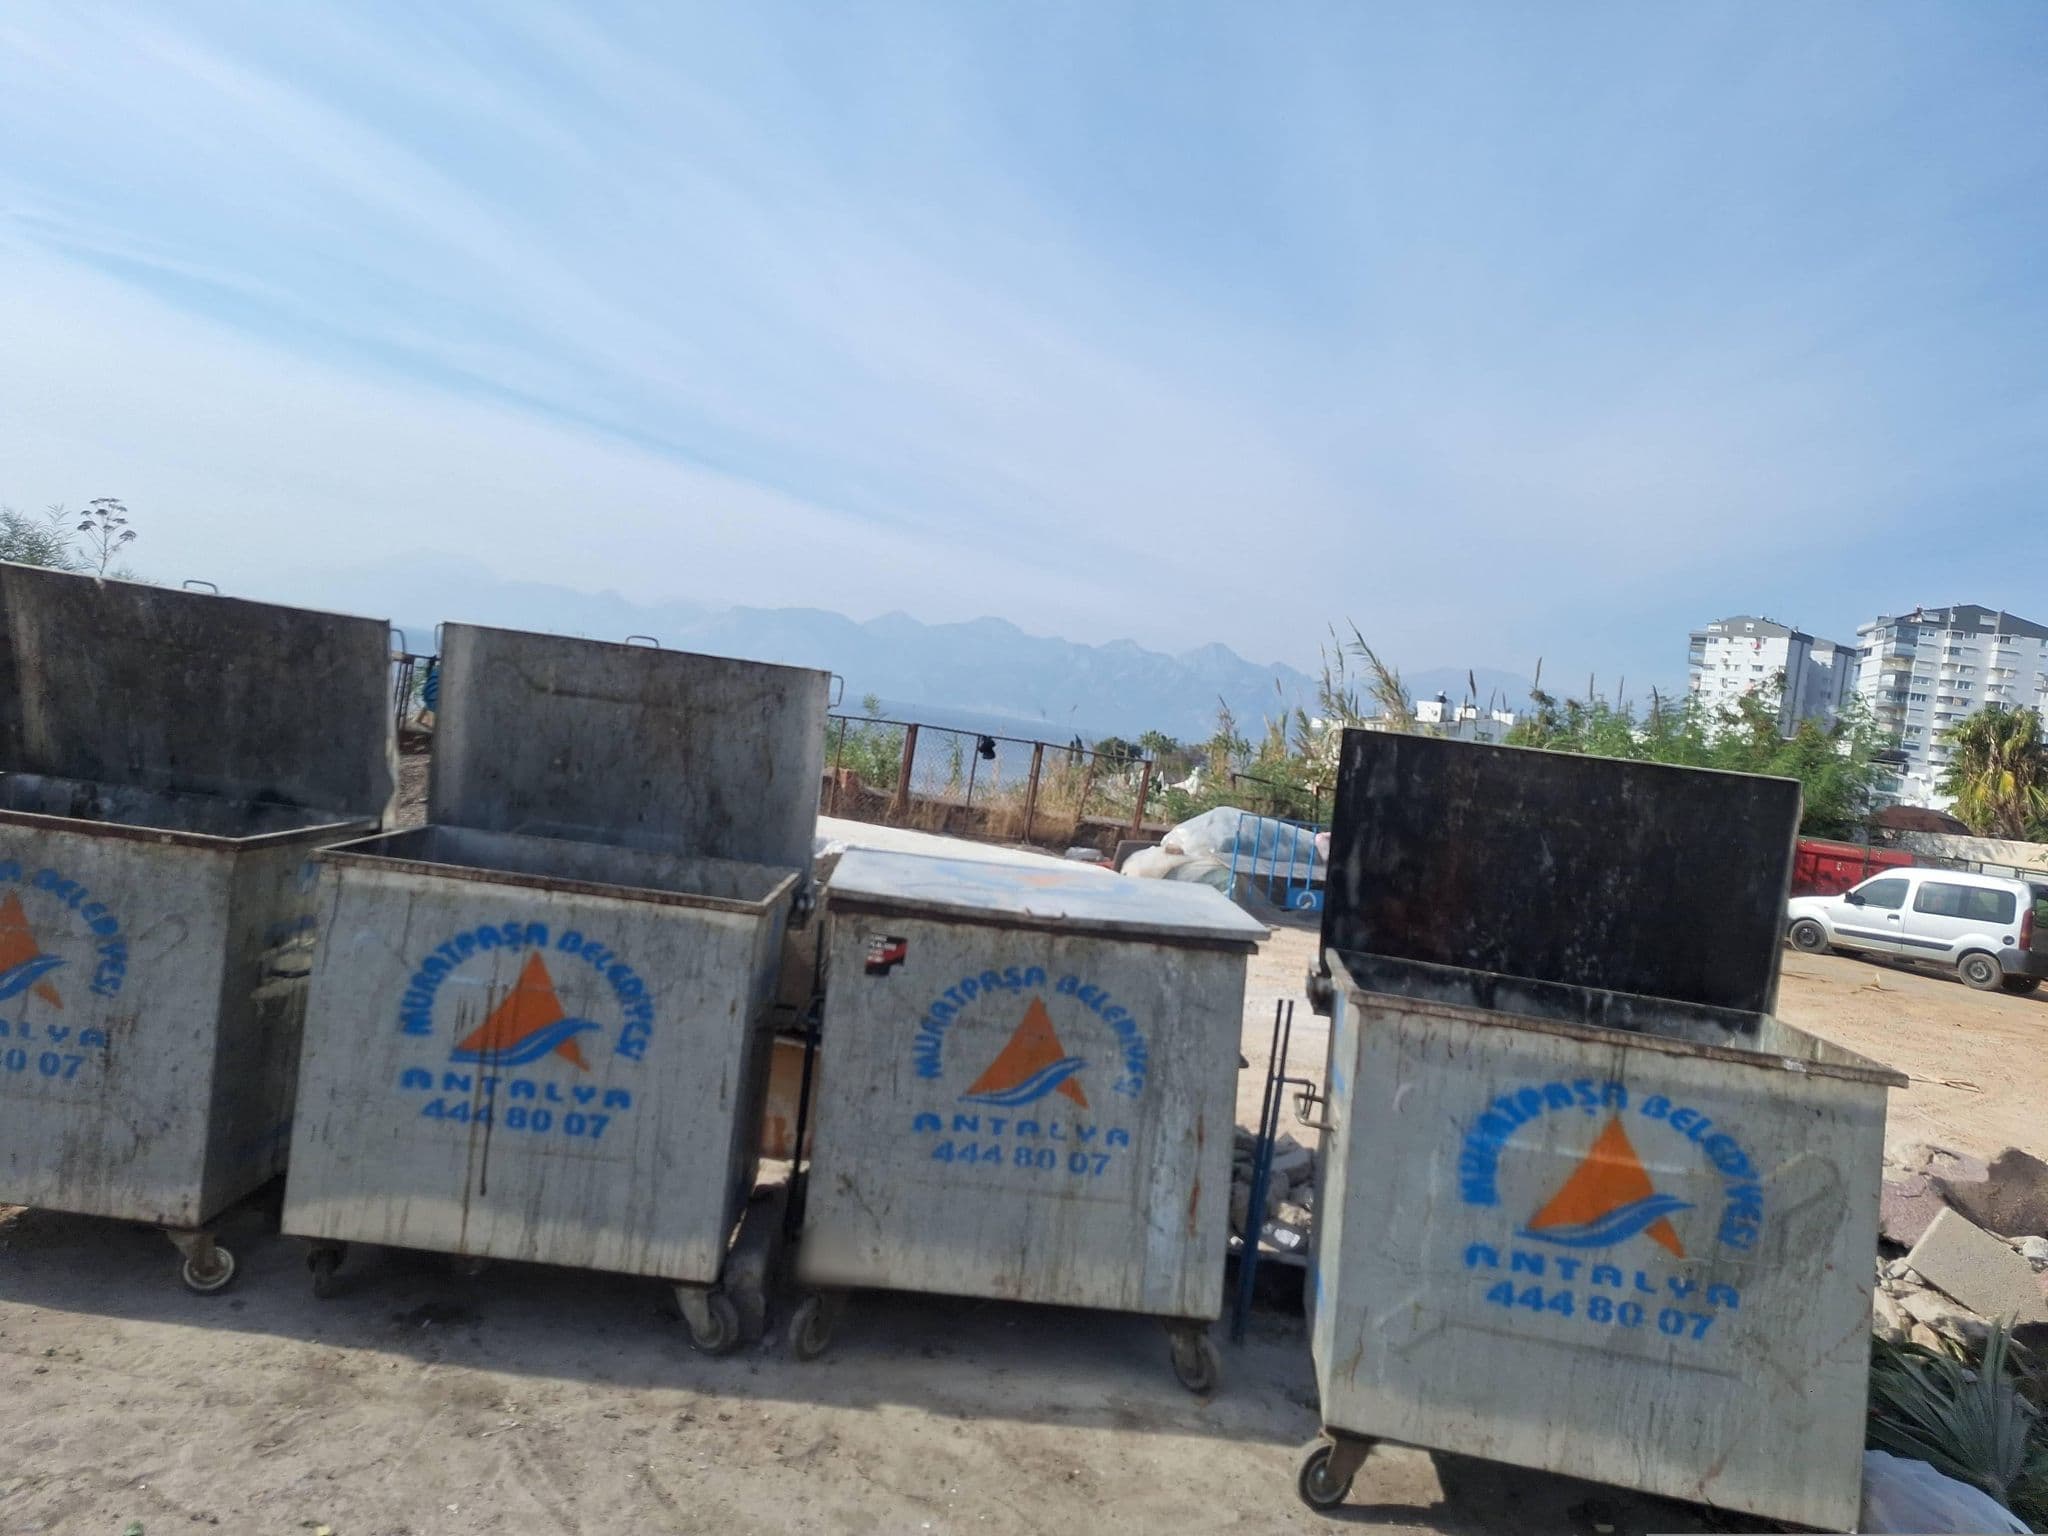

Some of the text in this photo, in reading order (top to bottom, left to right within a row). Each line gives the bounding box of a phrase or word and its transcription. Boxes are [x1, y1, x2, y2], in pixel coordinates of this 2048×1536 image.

[38, 1052, 84, 1079] 07
[400, 1066, 632, 1110] ANTALYA
[421, 1097, 612, 1140] 444 80 07
[912, 1112, 1130, 1148] ANTALYA
[932, 1140, 1111, 1176] 444 80 07
[1463, 1242, 1740, 1310] ANTALYA
[1485, 1280, 1715, 1341] 444 80 07
